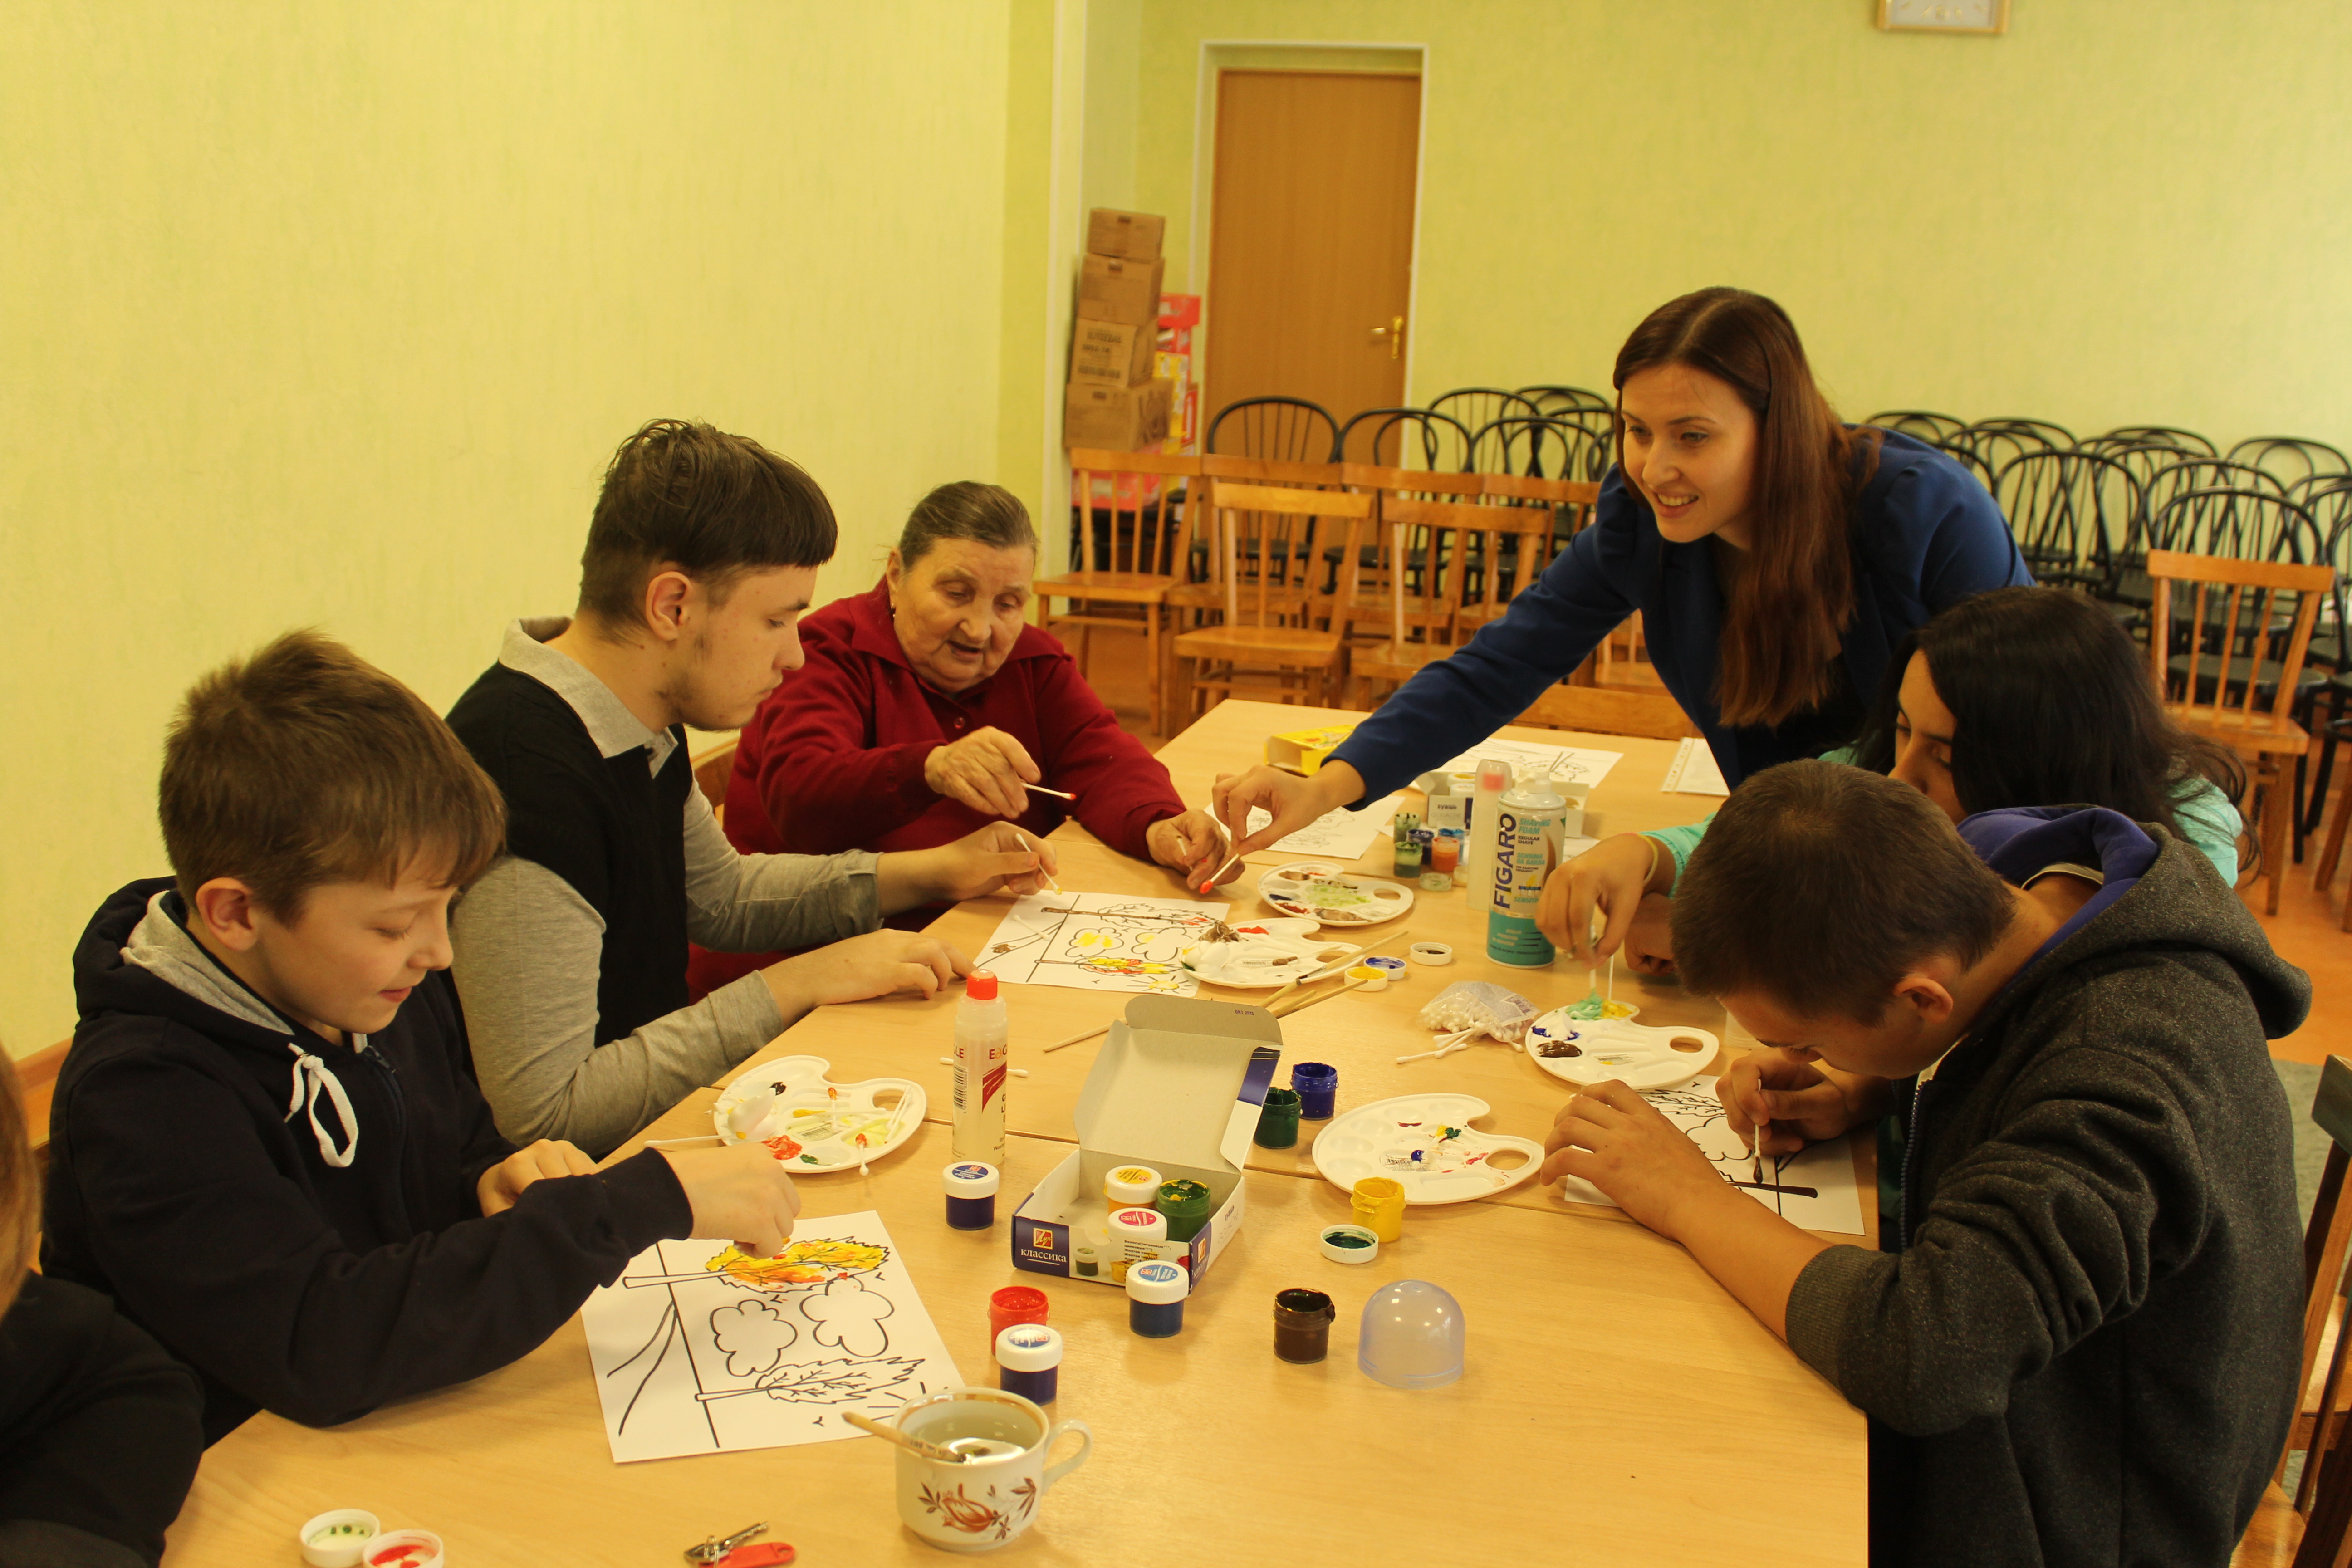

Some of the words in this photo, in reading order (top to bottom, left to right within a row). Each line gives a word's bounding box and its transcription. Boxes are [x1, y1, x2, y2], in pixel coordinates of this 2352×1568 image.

[1519, 818, 1551, 827] SHAVING
[1518, 827, 1541, 835] FOAM
[1494, 813, 1517, 909] FIGARO
[1020, 1248, 1067, 1263] классика
